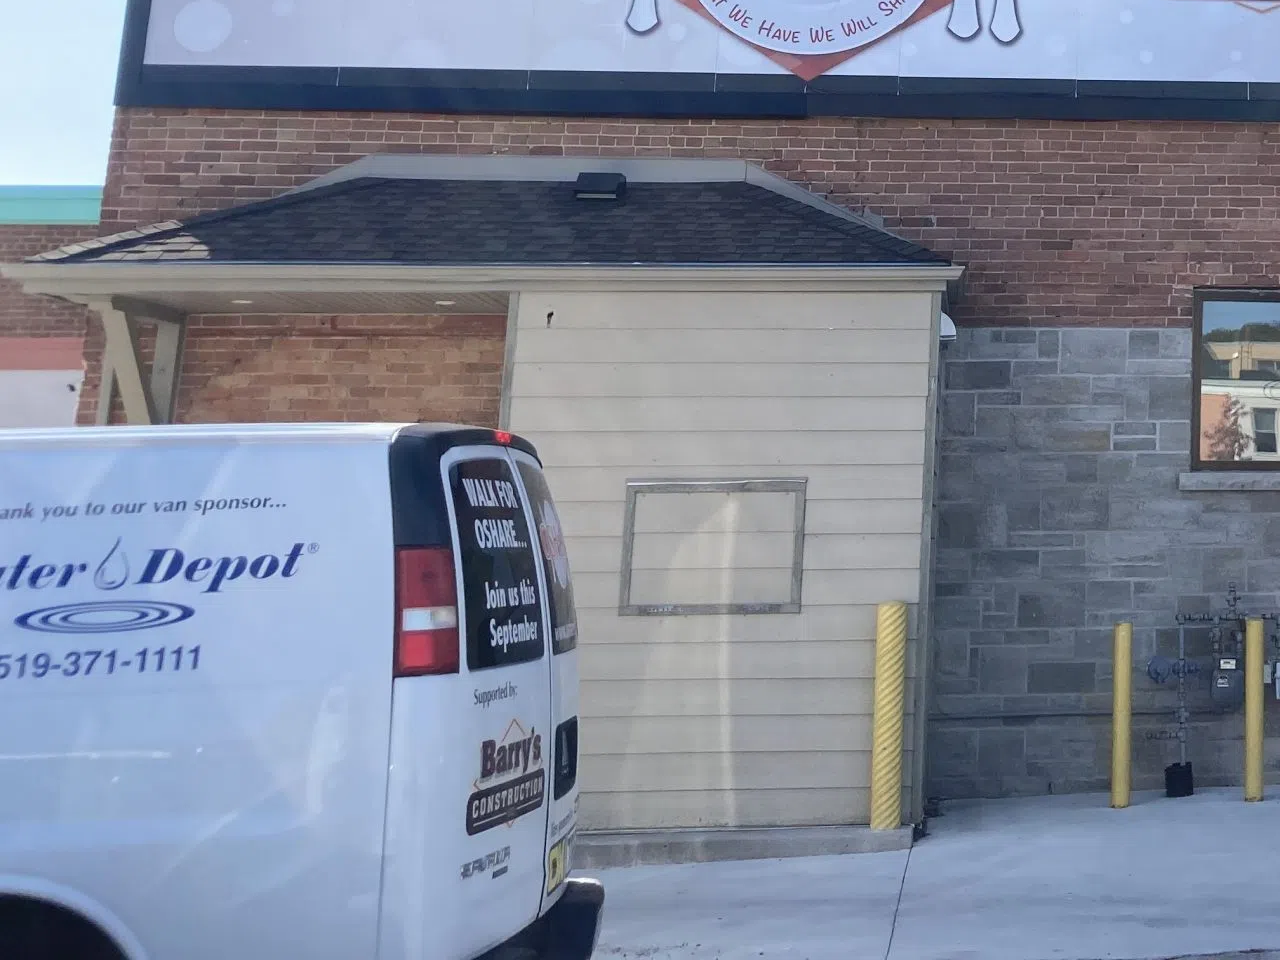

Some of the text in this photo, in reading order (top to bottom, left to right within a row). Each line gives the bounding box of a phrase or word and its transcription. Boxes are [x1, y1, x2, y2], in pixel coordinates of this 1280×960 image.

[41, 504, 78, 522] you
[84, 501, 106, 516] to
[111, 500, 147, 515] our
[153, 499, 187, 513] van
[193, 496, 287, 516] sponsor...
[462, 478, 518, 509] WALK FOR
[474, 518, 528, 549] OSHARE...
[484, 578, 536, 610] Join us this
[489, 615, 538, 652] September
[474, 681, 508, 708] Supported
[480, 726, 541, 779] Barry's
[472, 777, 543, 819] CONSTRUCTION
